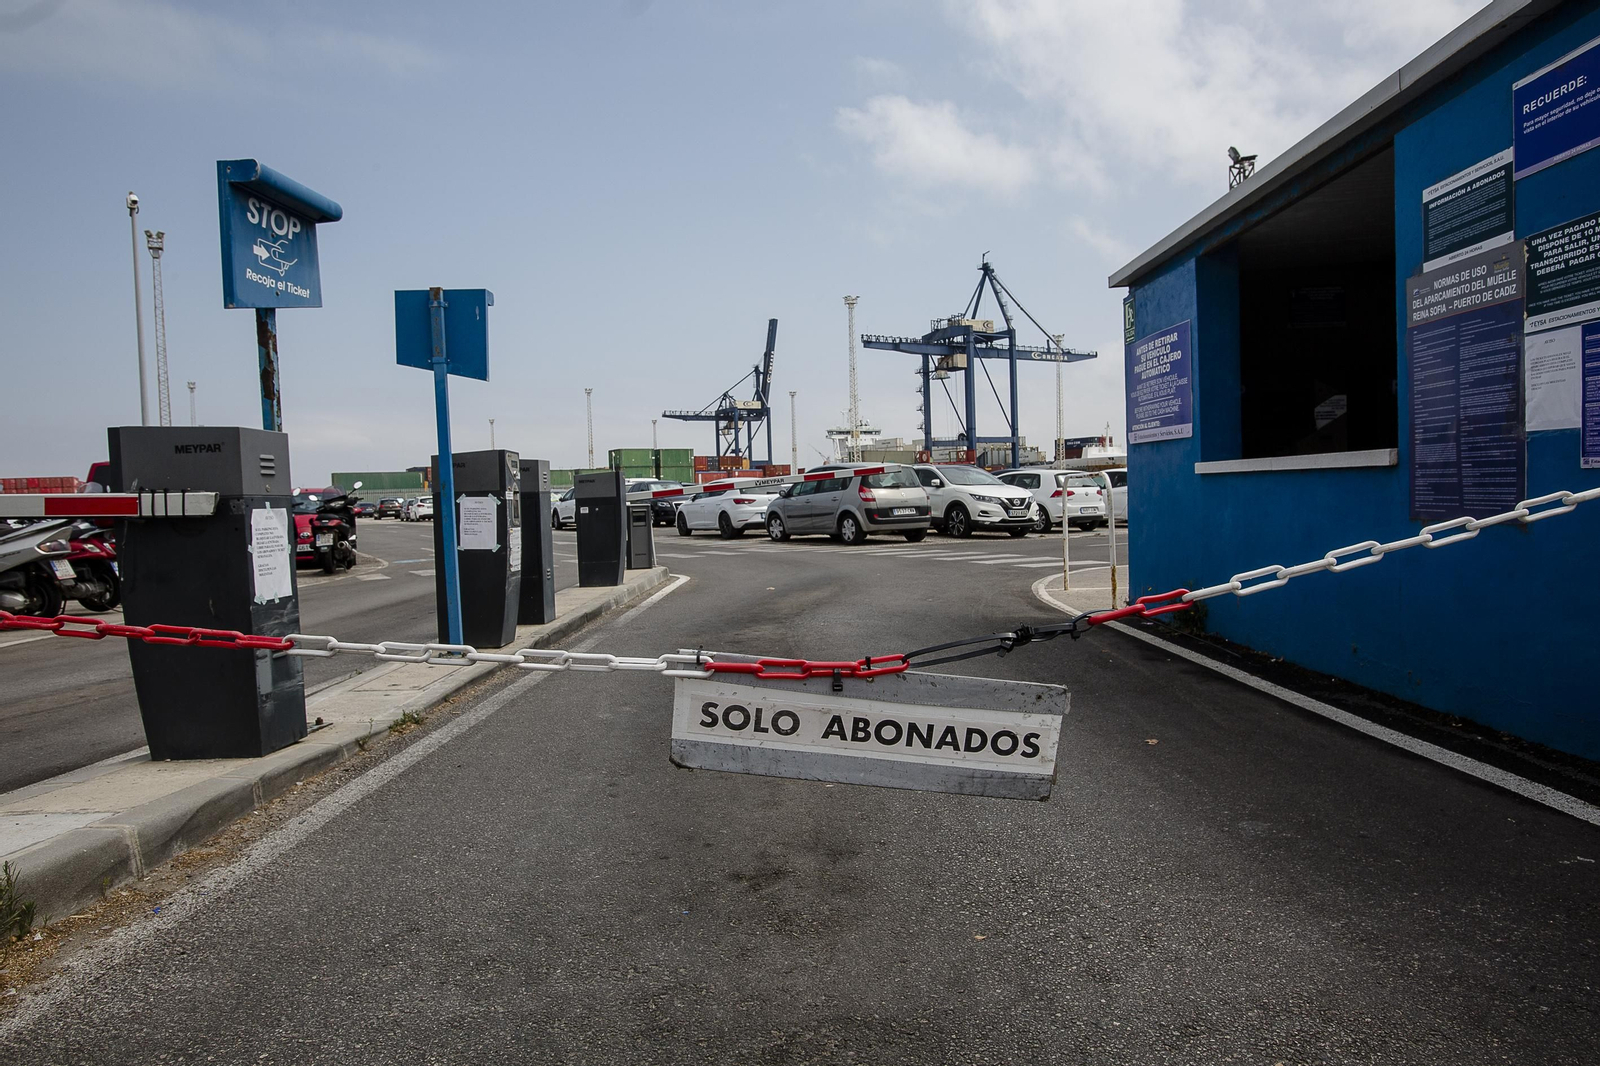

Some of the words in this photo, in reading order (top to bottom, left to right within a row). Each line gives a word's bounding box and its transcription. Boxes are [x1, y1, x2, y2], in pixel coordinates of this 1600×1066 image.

[1523, 75, 1588, 115] RECUERDE:
[1576, 95, 1584, 103] no
[1565, 107, 1572, 116] de
[1428, 187, 1466, 210] INFORMACIÓN
[1472, 169, 1506, 190] ABONADOS
[247, 197, 301, 240] STOP
[1531, 238, 1547, 246] UNA
[1548, 231, 1563, 240] VEZ
[1564, 218, 1596, 235] PAGADO
[1538, 237, 1570, 252] DISPONE
[1571, 234, 1582, 242] DE
[1584, 228, 1594, 238] 10
[1530, 248, 1588, 270] TRANSCURRIDO
[1544, 246, 1563, 259] PARA
[1564, 240, 1590, 252] SALIR,
[1434, 274, 1460, 290] NORMAS
[1460, 272, 1470, 282] DE
[1472, 264, 1487, 278] USO
[1536, 261, 1566, 276] DEBERÁ
[1569, 254, 1596, 268] PAGAR
[246, 268, 276, 290] Recoja
[278, 280, 286, 292] el
[287, 283, 310, 299] Ticket
[1412, 299, 1424, 310] DEL
[1424, 285, 1470, 308] APARCAMIENTO
[1471, 280, 1486, 292] DEL
[1486, 269, 1517, 288] MUELLE
[1412, 308, 1430, 322] REINA
[1430, 304, 1447, 318] SOFIA
[1454, 294, 1482, 311] PUERTO
[1482, 291, 1493, 302] DE
[1494, 283, 1517, 300] CADIZ
[1548, 308, 1596, 324] ESTACIONAMIENTOS
[1136, 344, 1148, 356] ANTES
[1148, 340, 1155, 350] DE
[1154, 332, 1178, 348] RETIRAR
[1134, 363, 1147, 374] PAGUE
[1147, 360, 1153, 370] EN
[1153, 358, 1160, 367] EL
[1160, 350, 1182, 364] CAJERO
[1140, 353, 1147, 363] SU
[175, 444, 222, 454] MEYPAR
[700, 702, 800, 736] SOLO
[821, 714, 1042, 758] ABONADOS
